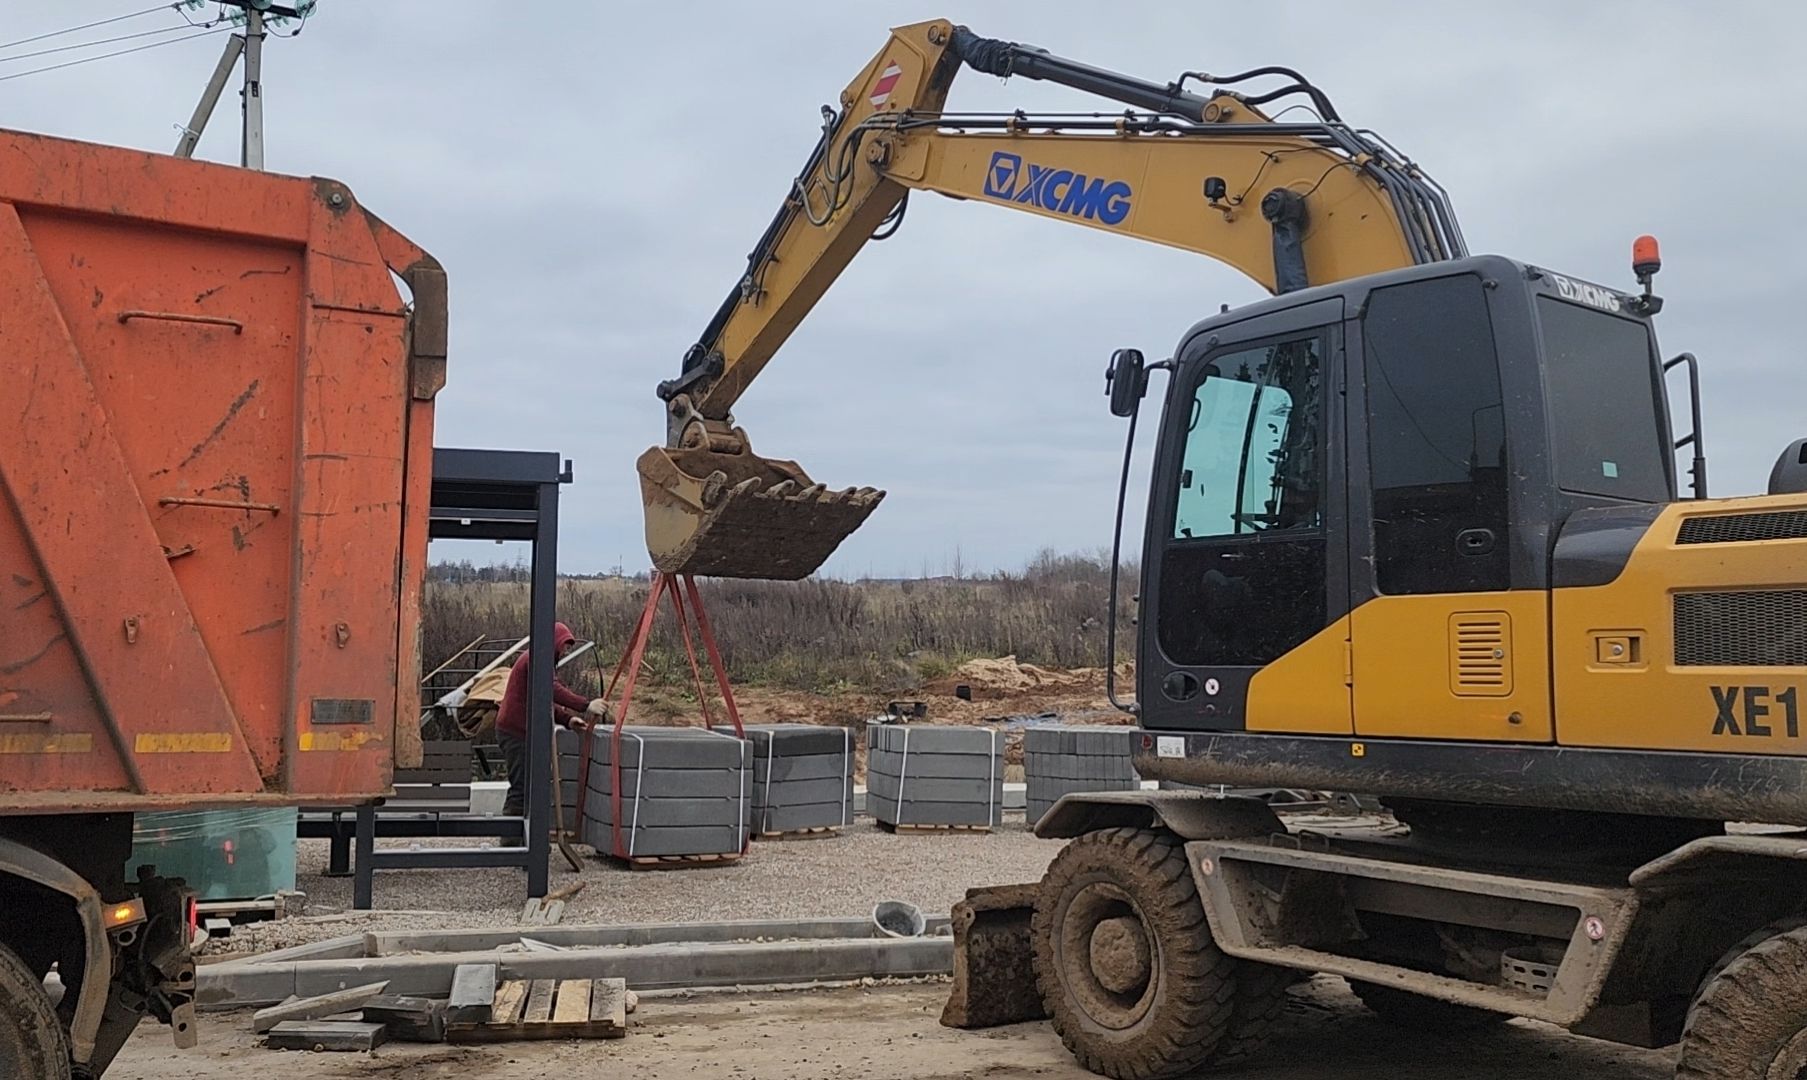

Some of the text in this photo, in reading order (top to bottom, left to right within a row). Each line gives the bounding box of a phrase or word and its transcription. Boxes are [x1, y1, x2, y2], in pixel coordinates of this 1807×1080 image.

[1013, 163, 1132, 225] XCMG
[1572, 281, 1620, 312] XCMG
[1709, 686, 1799, 738] XE1
